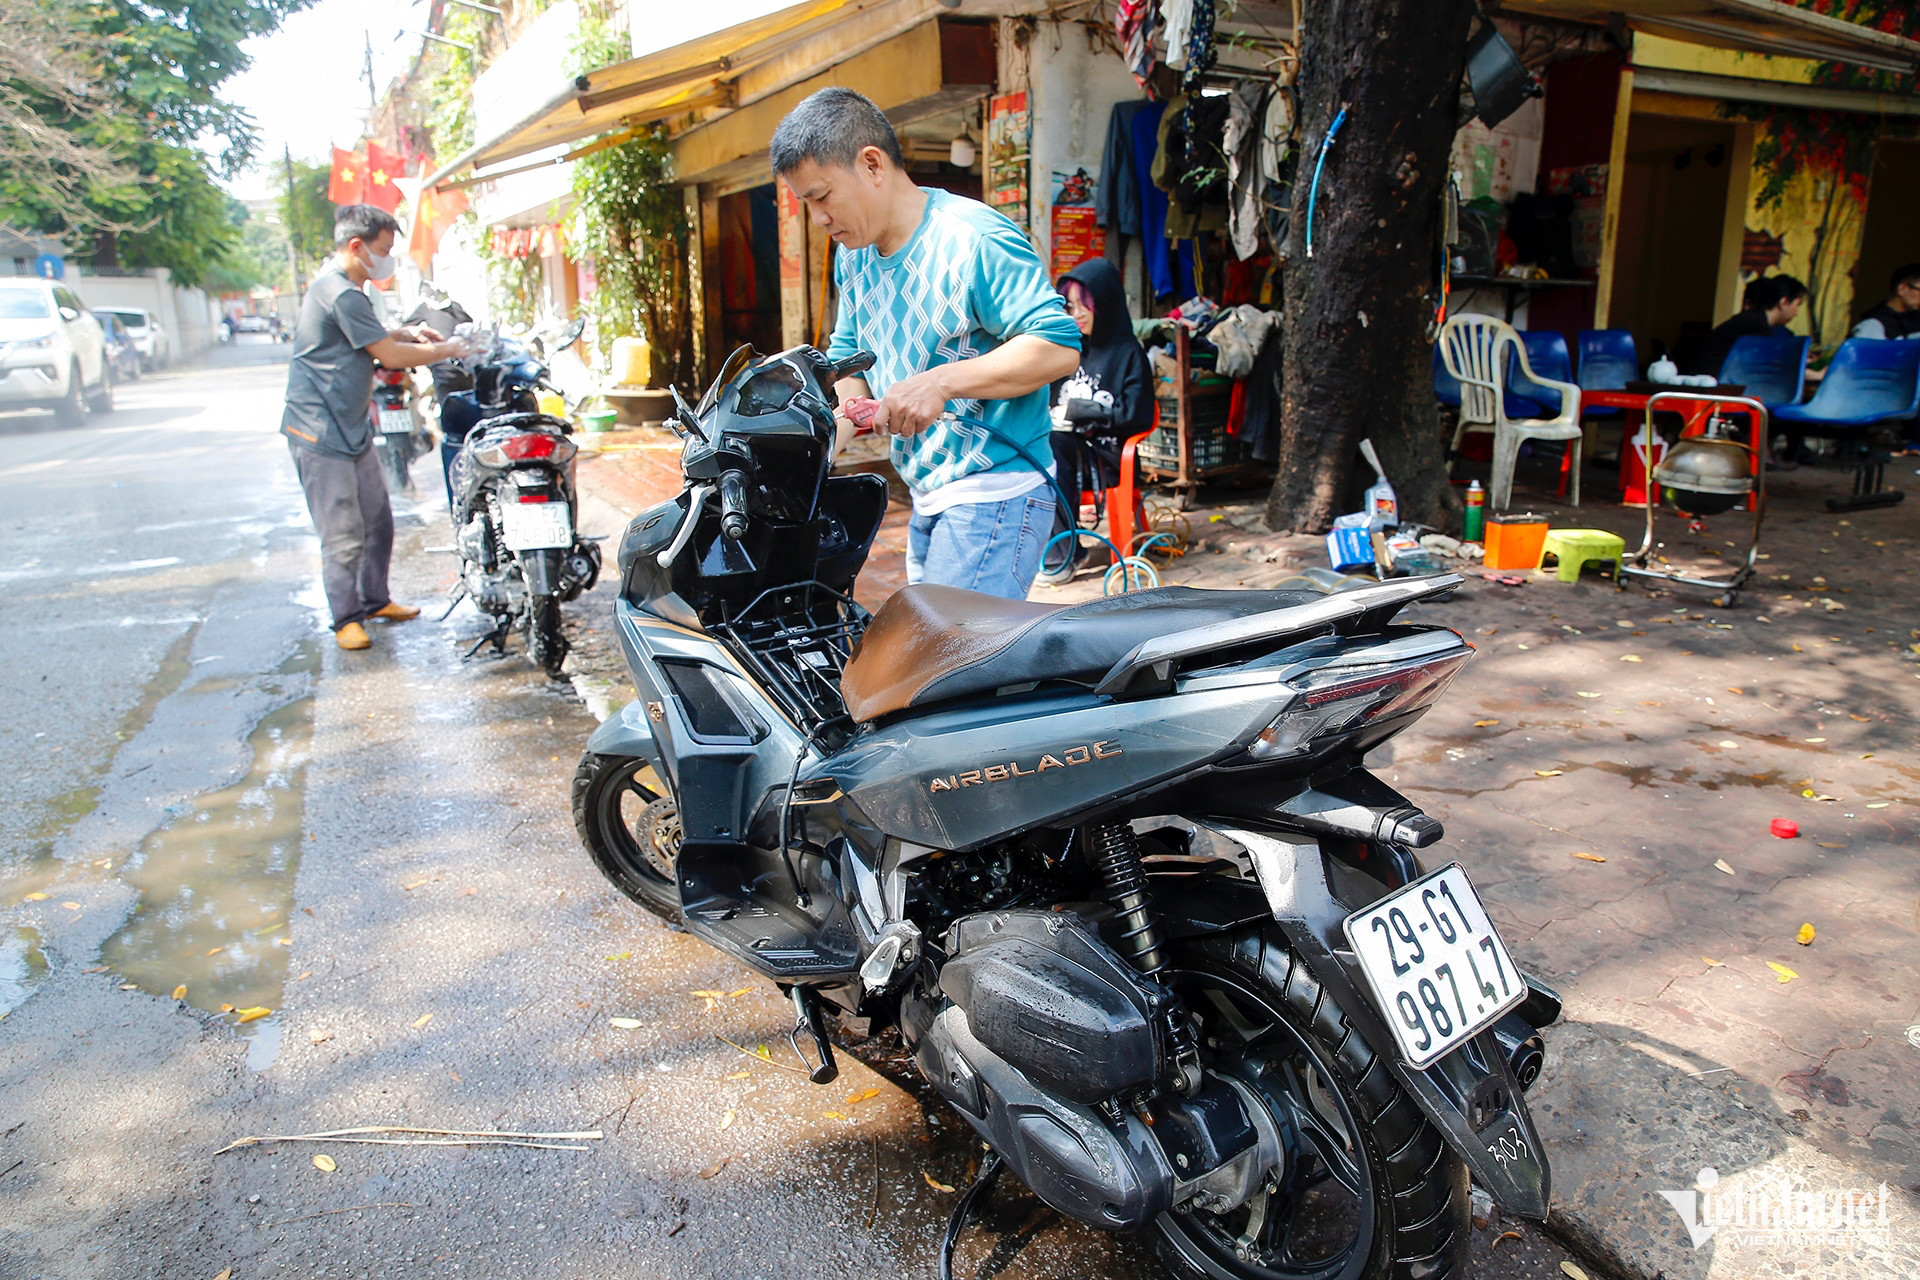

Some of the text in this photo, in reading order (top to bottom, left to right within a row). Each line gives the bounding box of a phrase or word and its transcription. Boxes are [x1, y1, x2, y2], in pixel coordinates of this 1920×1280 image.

[930, 738, 1123, 794] AIRBLADE
[1371, 879, 1473, 978] 29-G1
[1396, 935, 1510, 1051] 987.47
[1487, 1127, 1528, 1168] 303
